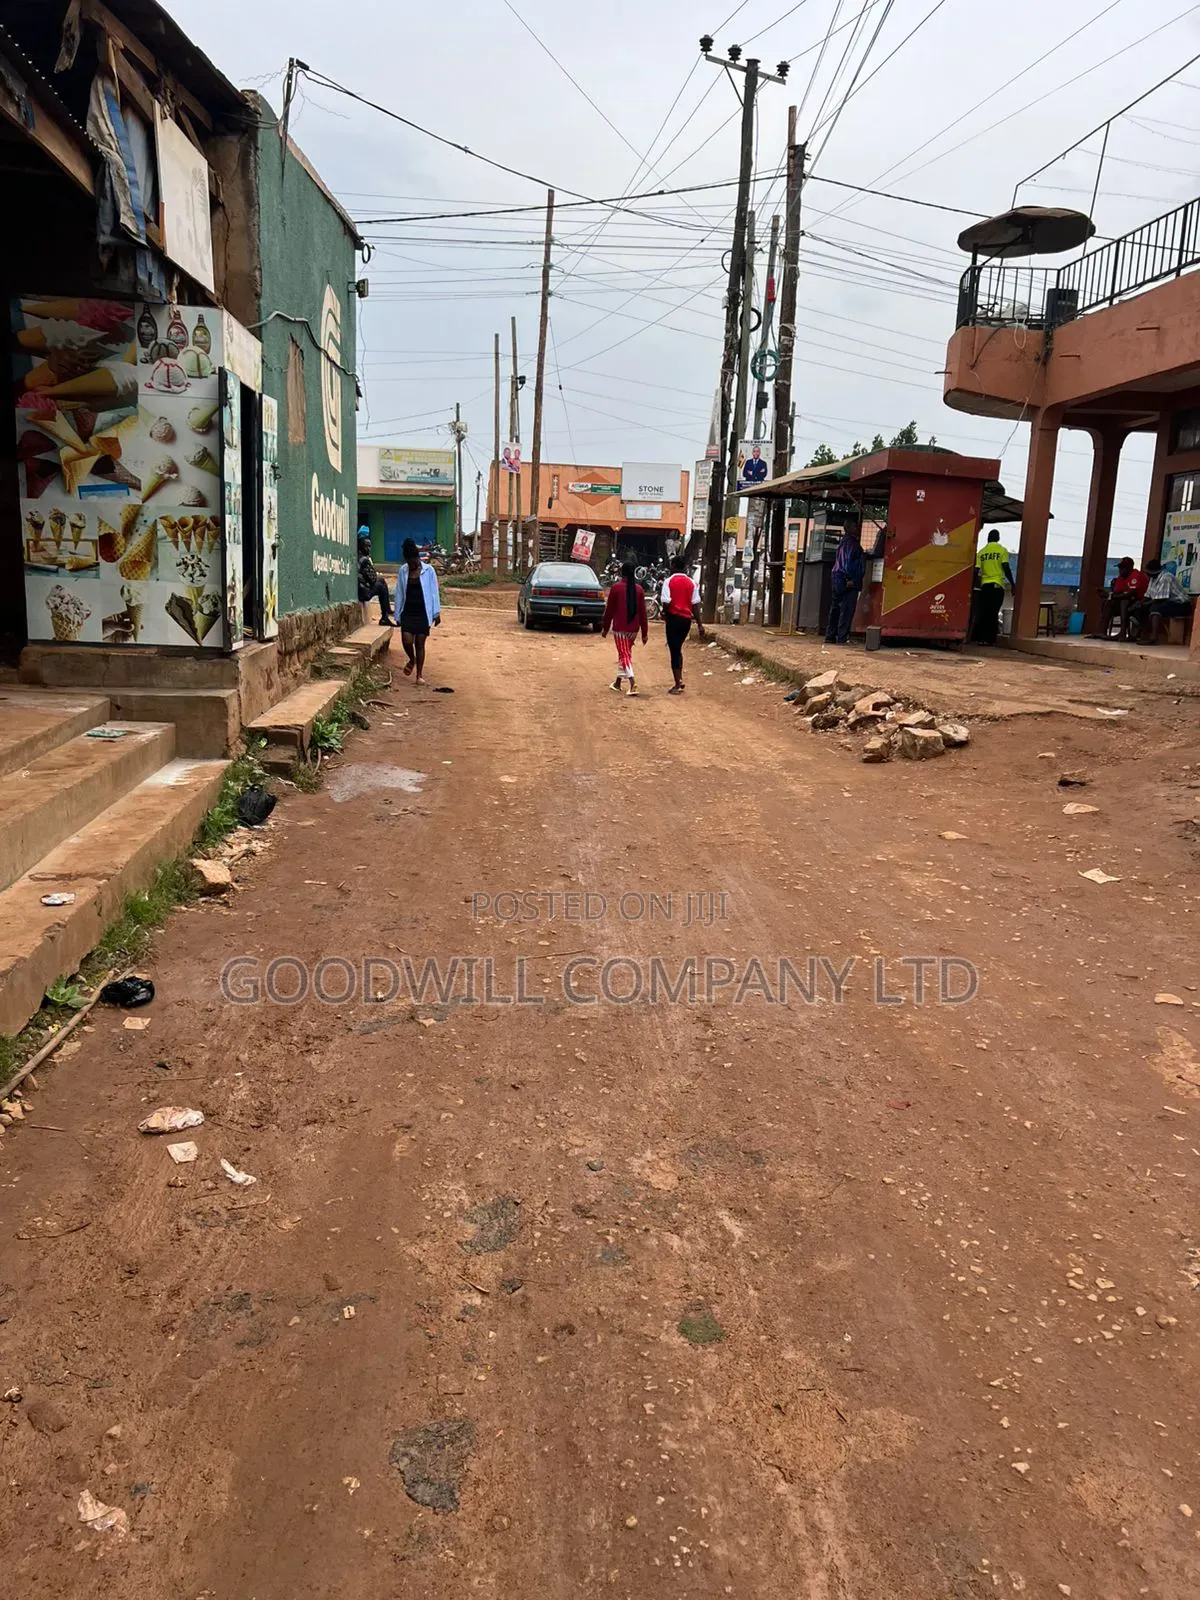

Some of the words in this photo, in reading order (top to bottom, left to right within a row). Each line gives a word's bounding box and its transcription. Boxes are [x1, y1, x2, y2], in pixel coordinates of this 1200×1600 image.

[638, 485, 664, 493] STONE
[312, 472, 349, 546] Goodwill
[980, 552, 1000, 561] STAFF
